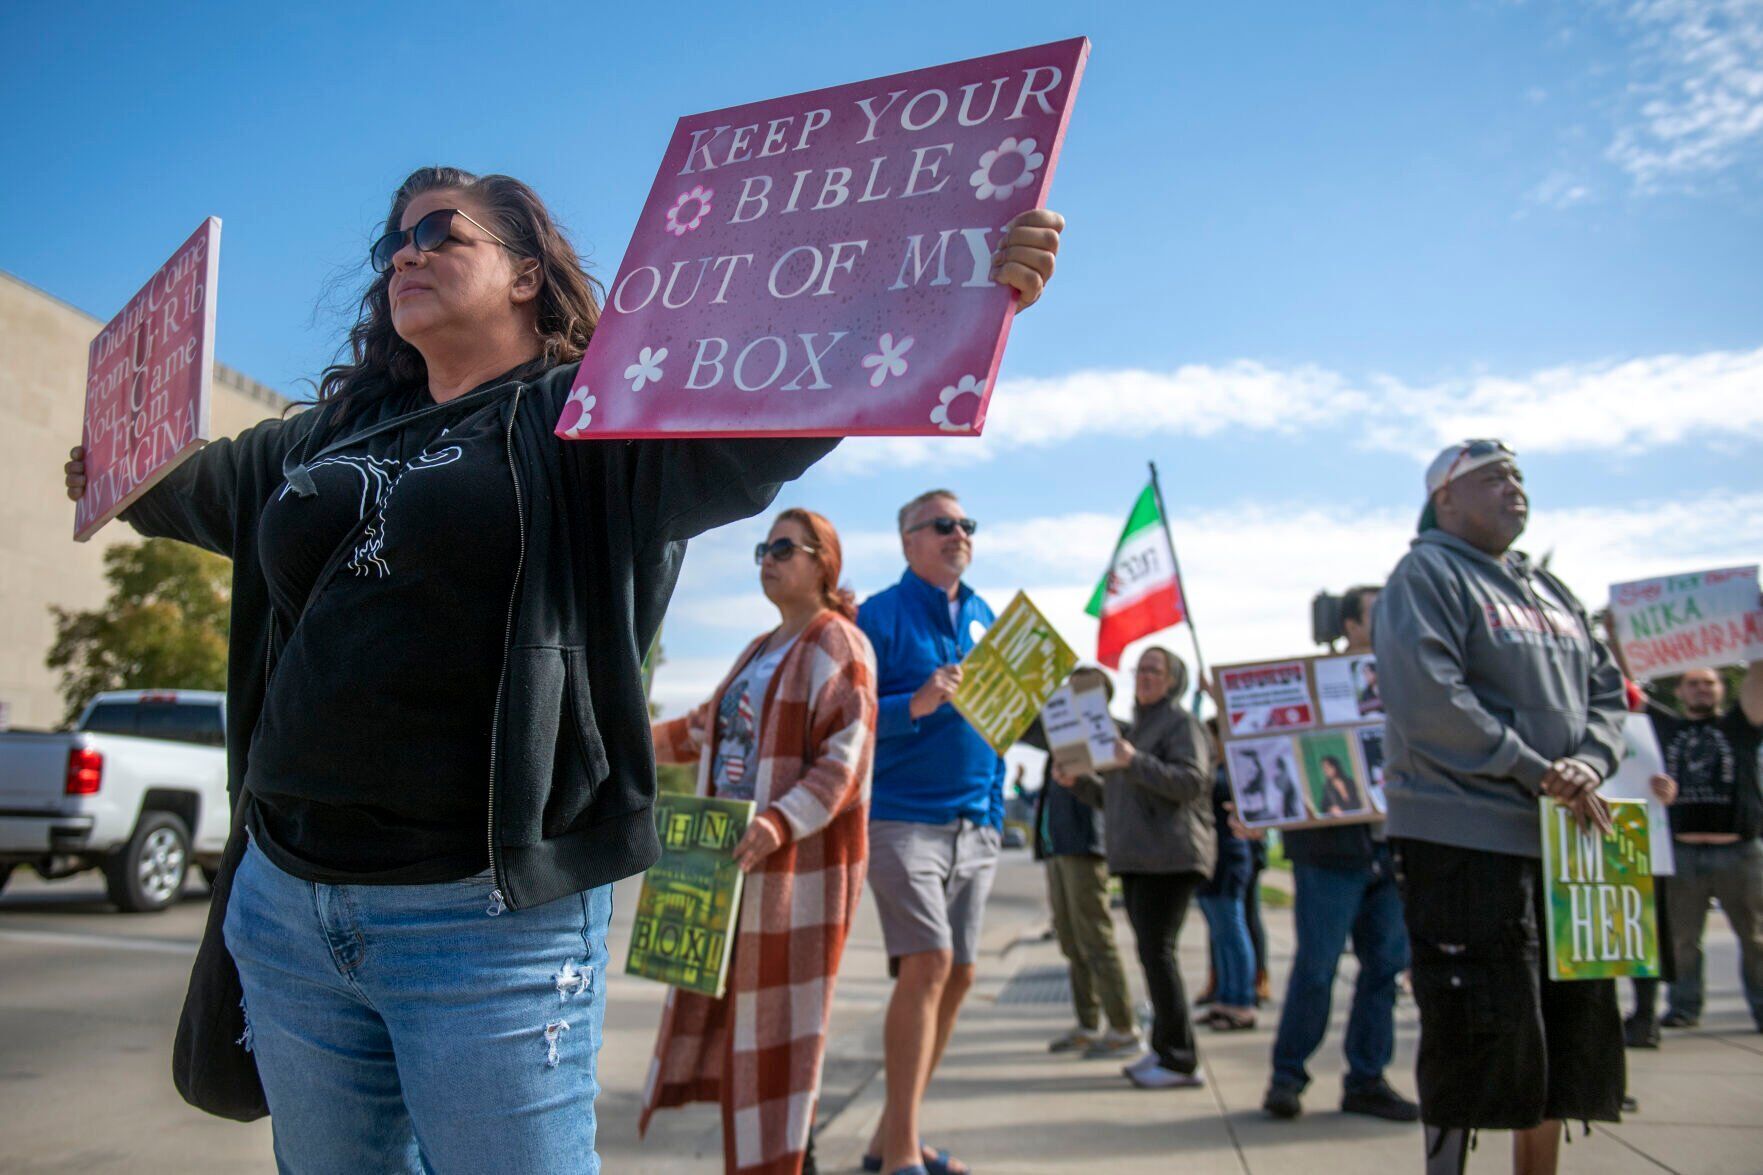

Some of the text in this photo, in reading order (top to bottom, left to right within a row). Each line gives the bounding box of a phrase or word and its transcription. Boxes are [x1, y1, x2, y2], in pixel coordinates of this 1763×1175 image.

[677, 65, 1063, 176] KEEP YOUR
[726, 143, 953, 224] BIBLE
[147, 236, 206, 312] Come
[614, 227, 1009, 314] OUT OF MY
[85, 336, 197, 453] You Came
[86, 356, 130, 416] From
[684, 331, 849, 391] BOX
[108, 398, 199, 504] VAGINA
[109, 389, 168, 466] From
[1630, 594, 1702, 640] NIKA
[1568, 884, 1646, 962] HER
